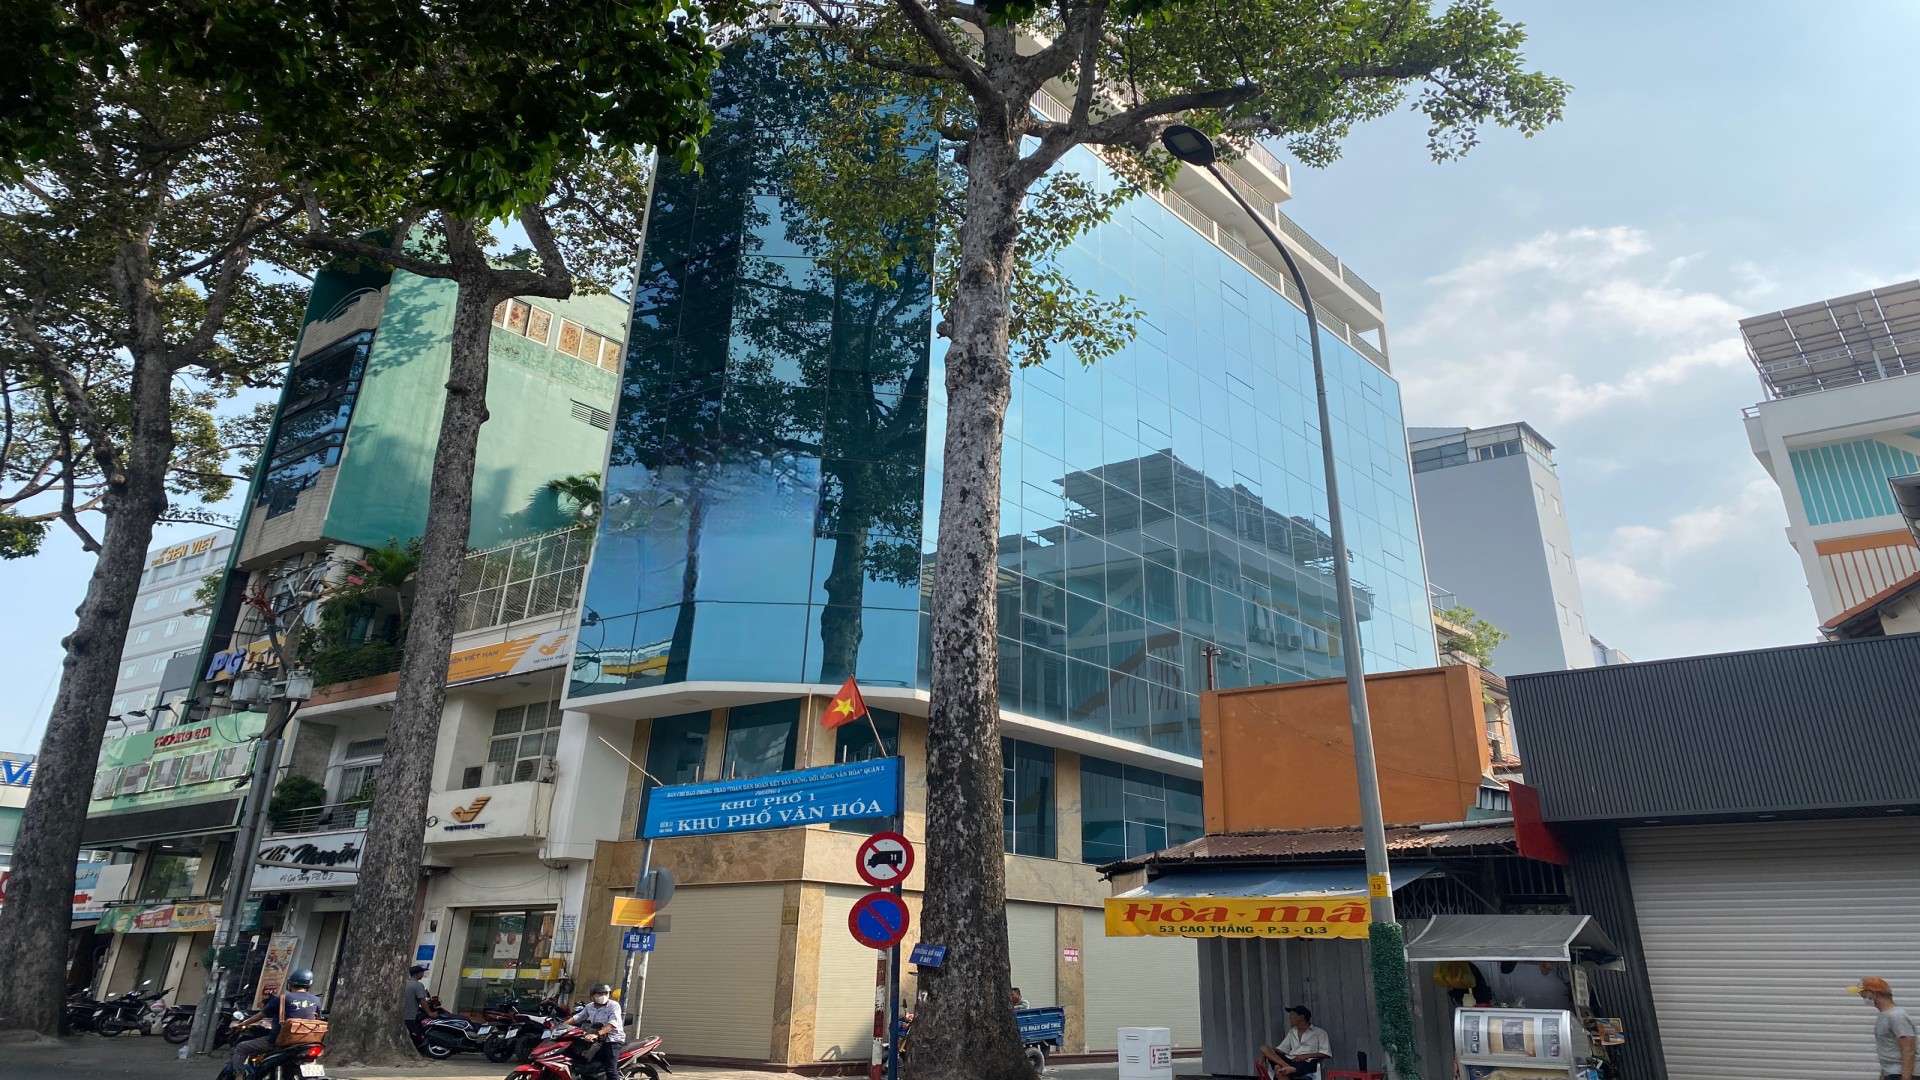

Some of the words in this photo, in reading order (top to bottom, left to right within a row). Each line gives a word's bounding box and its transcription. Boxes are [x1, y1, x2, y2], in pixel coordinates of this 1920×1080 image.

[205, 648, 247, 680] PG
[720, 798, 759, 811] KHU
[763, 790, 803, 806] PHỐ
[808, 792, 816, 801] 1
[677, 816, 722, 832] KHU
[726, 806, 772, 828] PHỐ
[778, 804, 825, 822] VĂN
[831, 798, 882, 817] HÓA
[1122, 901, 1229, 923] Hòa
[1250, 902, 1368, 923] mã
[1209, 923, 1254, 933] THẮNG
[1268, 926, 1290, 934] P.3
[1304, 926, 1328, 934] Q.3
[642, 935, 650, 944] 51
